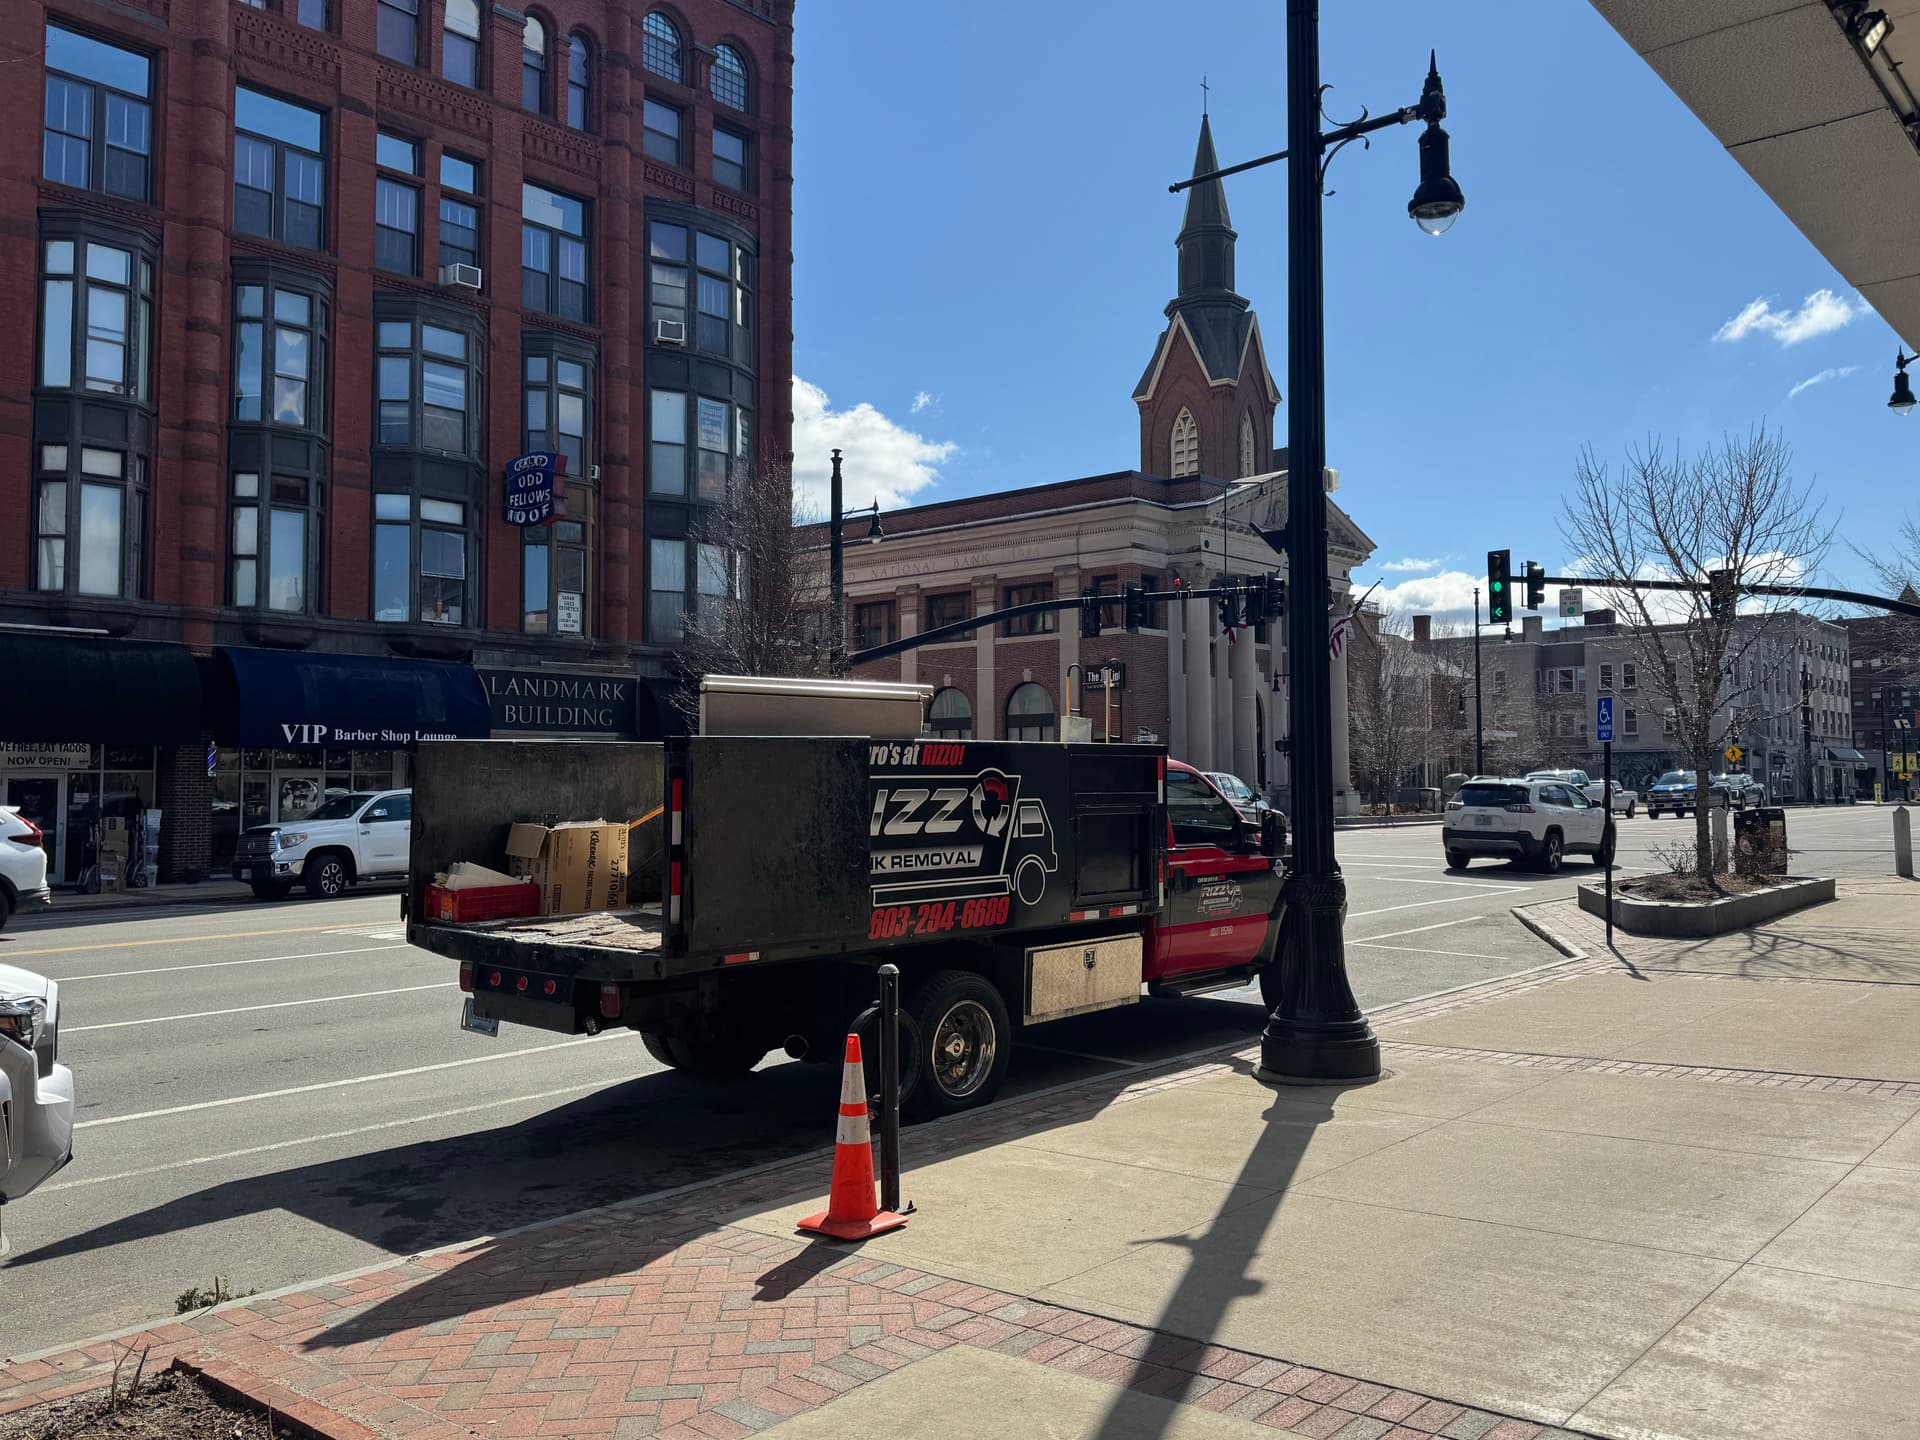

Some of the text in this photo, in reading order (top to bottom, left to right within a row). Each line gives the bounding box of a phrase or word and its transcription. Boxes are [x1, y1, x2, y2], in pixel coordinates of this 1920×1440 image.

[518, 472, 543, 488] ODD
[509, 488, 550, 507] FELLOWS
[871, 562, 936, 579] NATIONAL
[953, 552, 992, 568] BANK
[491, 676, 625, 701] LANDMARK
[504, 704, 613, 726] BUILDING
[281, 723, 328, 744] VIP
[334, 728, 378, 742] Barber
[380, 729, 411, 744] Shop
[39, 743, 56, 753] EAT
[59, 743, 87, 753] TACOS
[870, 743, 966, 767] ro's at RIZZO!
[7, 757, 36, 766] NOW
[38, 757, 71, 766] OPEN!
[870, 777, 1010, 838] IZZO
[890, 850, 977, 870] REMOVAL
[868, 896, 1010, 941] 603-294-6689
